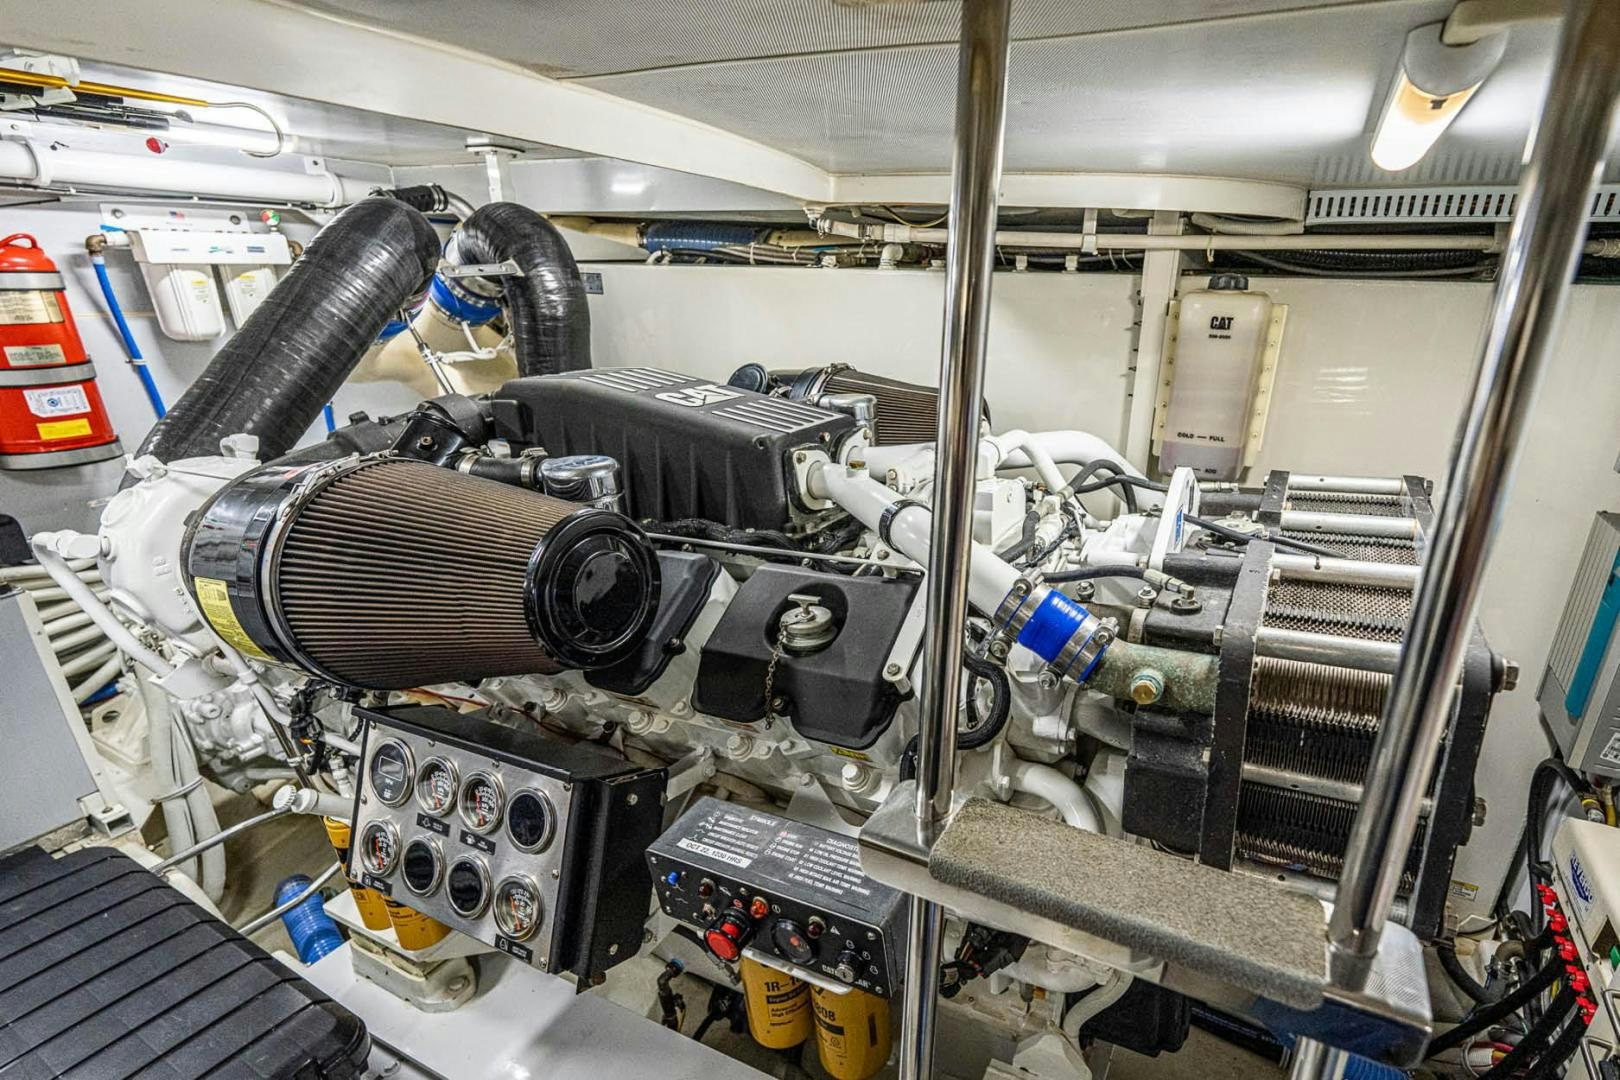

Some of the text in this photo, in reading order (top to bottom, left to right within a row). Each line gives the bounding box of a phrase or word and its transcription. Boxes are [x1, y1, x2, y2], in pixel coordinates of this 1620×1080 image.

[1210, 316, 1234, 330] CAT
[654, 384, 746, 407] CAT
[687, 842, 701, 850] OCT
[727, 855, 741, 864] HRS
